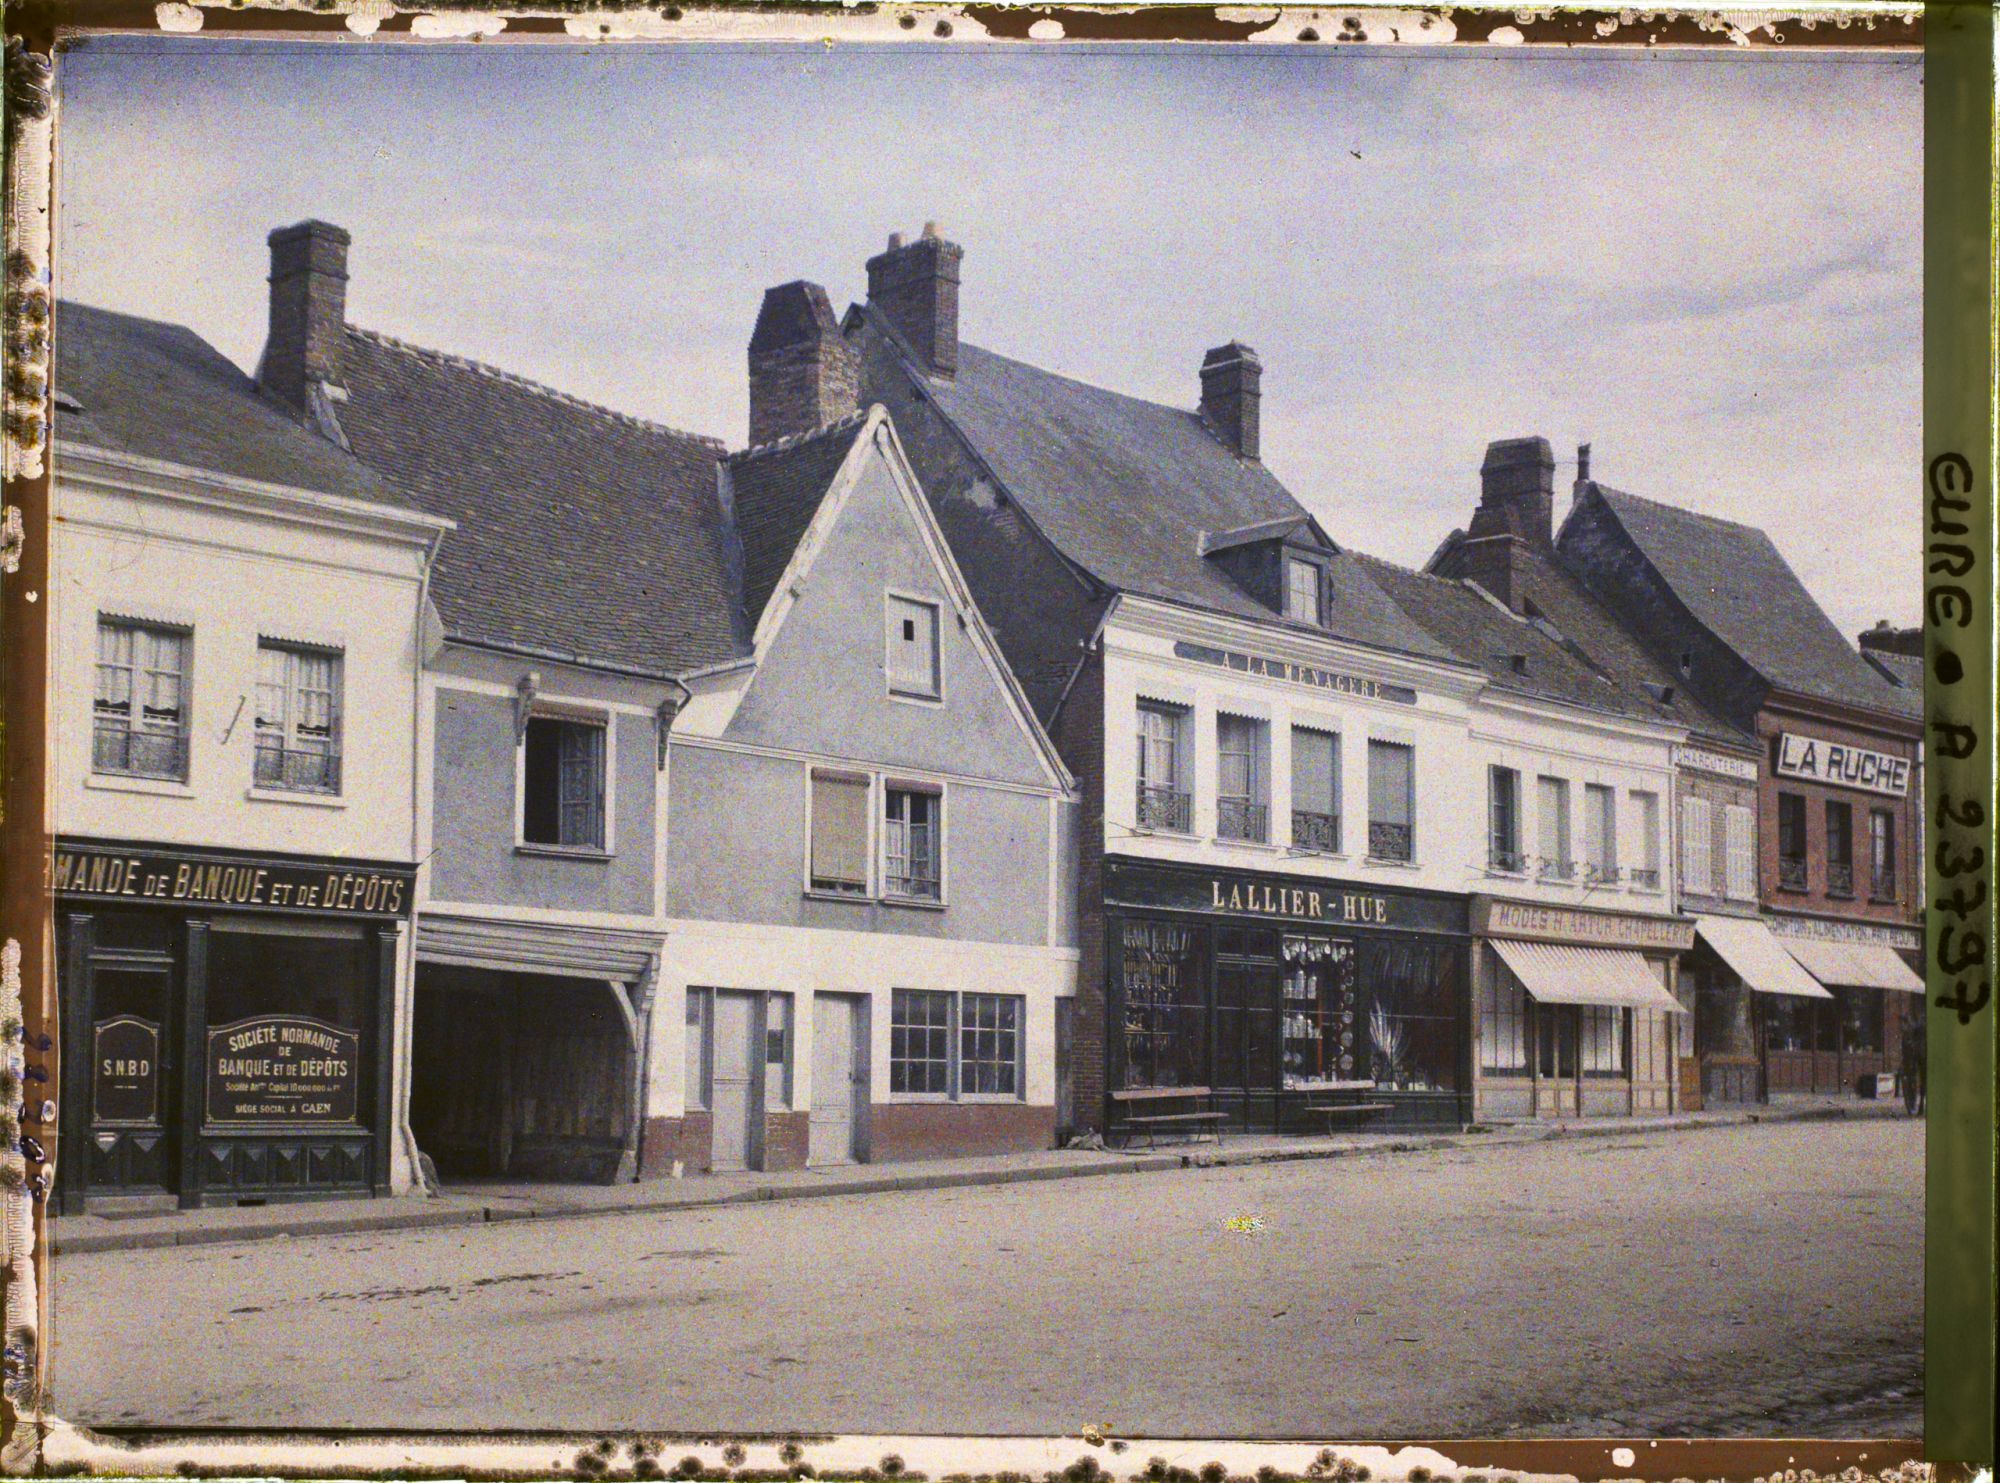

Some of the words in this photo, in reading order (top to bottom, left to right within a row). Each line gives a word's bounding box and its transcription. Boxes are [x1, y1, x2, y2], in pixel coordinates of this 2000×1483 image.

[1929, 451, 1976, 629] EURE
[1247, 655, 1269, 678] LA
[1929, 722, 1978, 761] A
[1781, 736, 1817, 776] LA
[1827, 745, 1908, 790] RUCHE
[143, 874, 170, 897] DE
[173, 862, 267, 904] BANQUE
[269, 882, 294, 905] ET
[295, 885, 320, 907] DE
[322, 873, 404, 913] DÉPÔTS
[1934, 793, 1991, 1027] 23797
[228, 1025, 277, 1052] SOCIÉTÉ
[281, 1027, 340, 1054] NORMANDE
[278, 1046, 292, 1057] DE
[218, 1058, 271, 1078] BANQUE
[273, 1063, 284, 1076] ET
[286, 1063, 297, 1076] DE
[300, 1057, 348, 1077] DÉPÔTS
[260, 1104, 286, 1114] SOCIAL
[301, 1102, 331, 1114] CAEN
